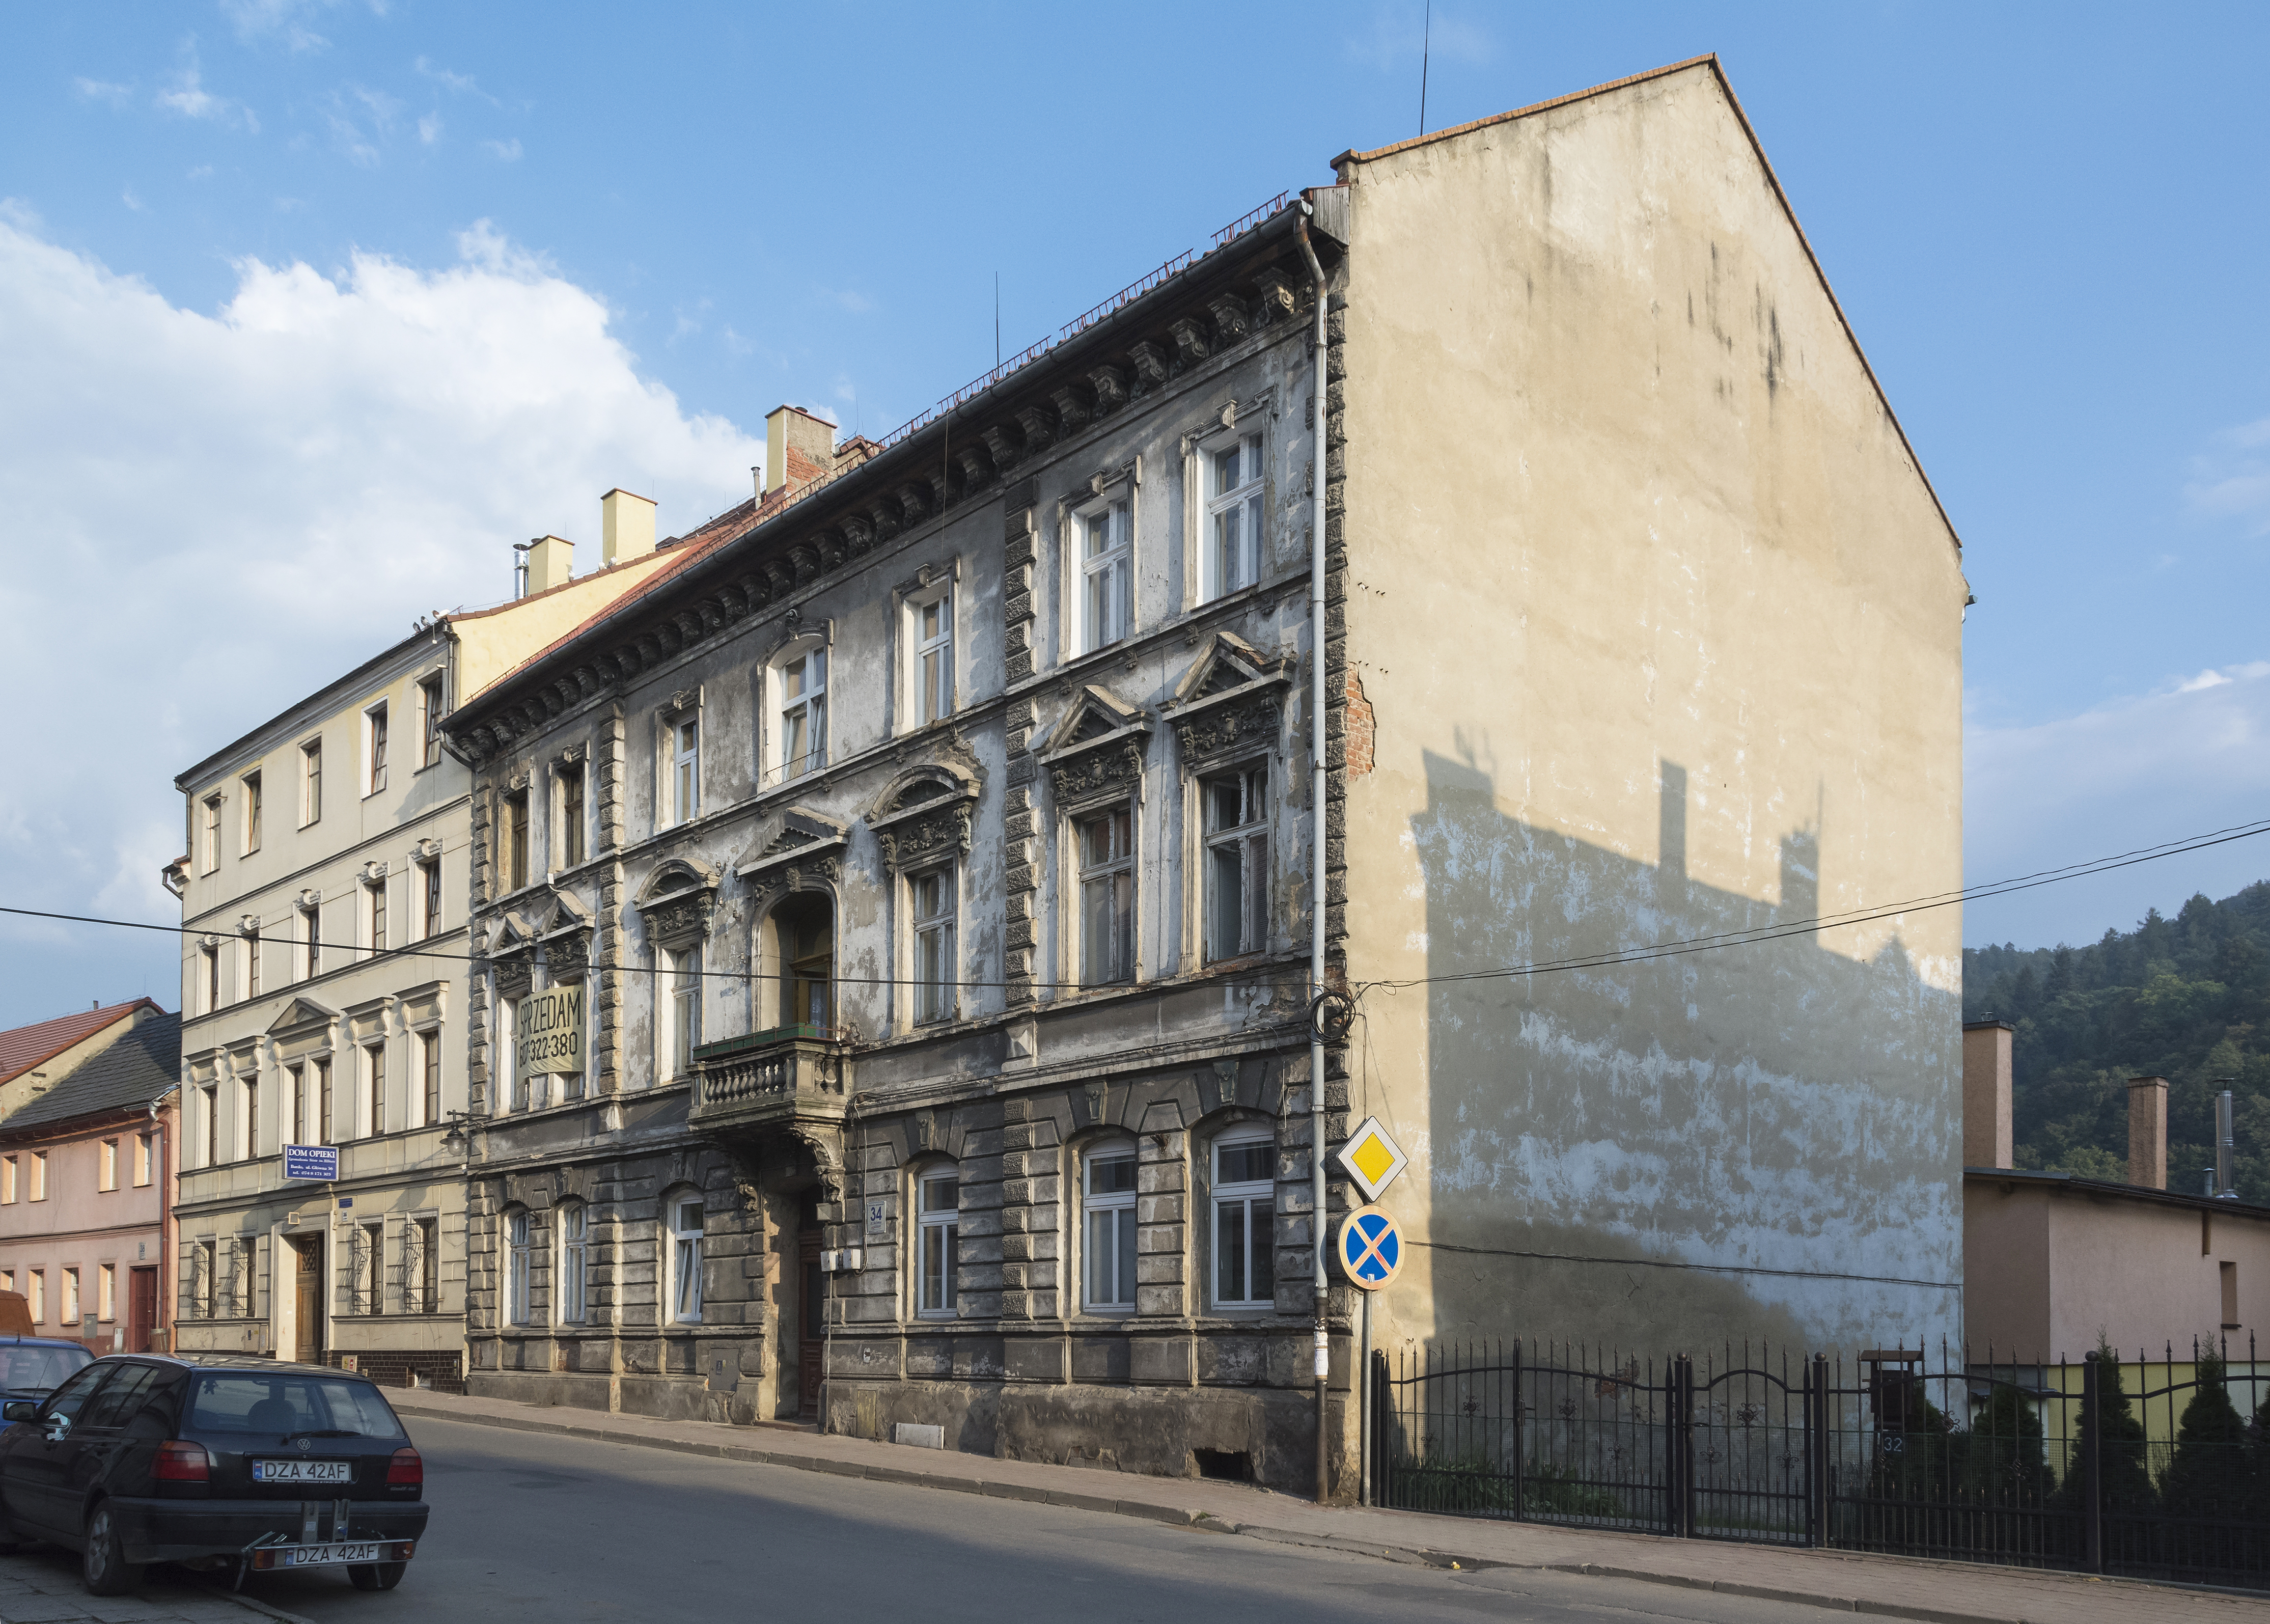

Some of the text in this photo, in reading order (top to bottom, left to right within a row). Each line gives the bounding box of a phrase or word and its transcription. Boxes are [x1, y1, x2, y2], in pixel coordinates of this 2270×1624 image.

[520, 990, 580, 1039] SPRZEDAM
[309, 1150, 335, 1158] OPIEKI
[871, 1206, 882, 1221] 34
[1884, 1437, 1902, 1452] 32
[265, 1462, 300, 1478] DZA
[307, 1463, 346, 1479] 42AF
[296, 1547, 329, 1563] DZA
[338, 1544, 376, 1560] 42AF
